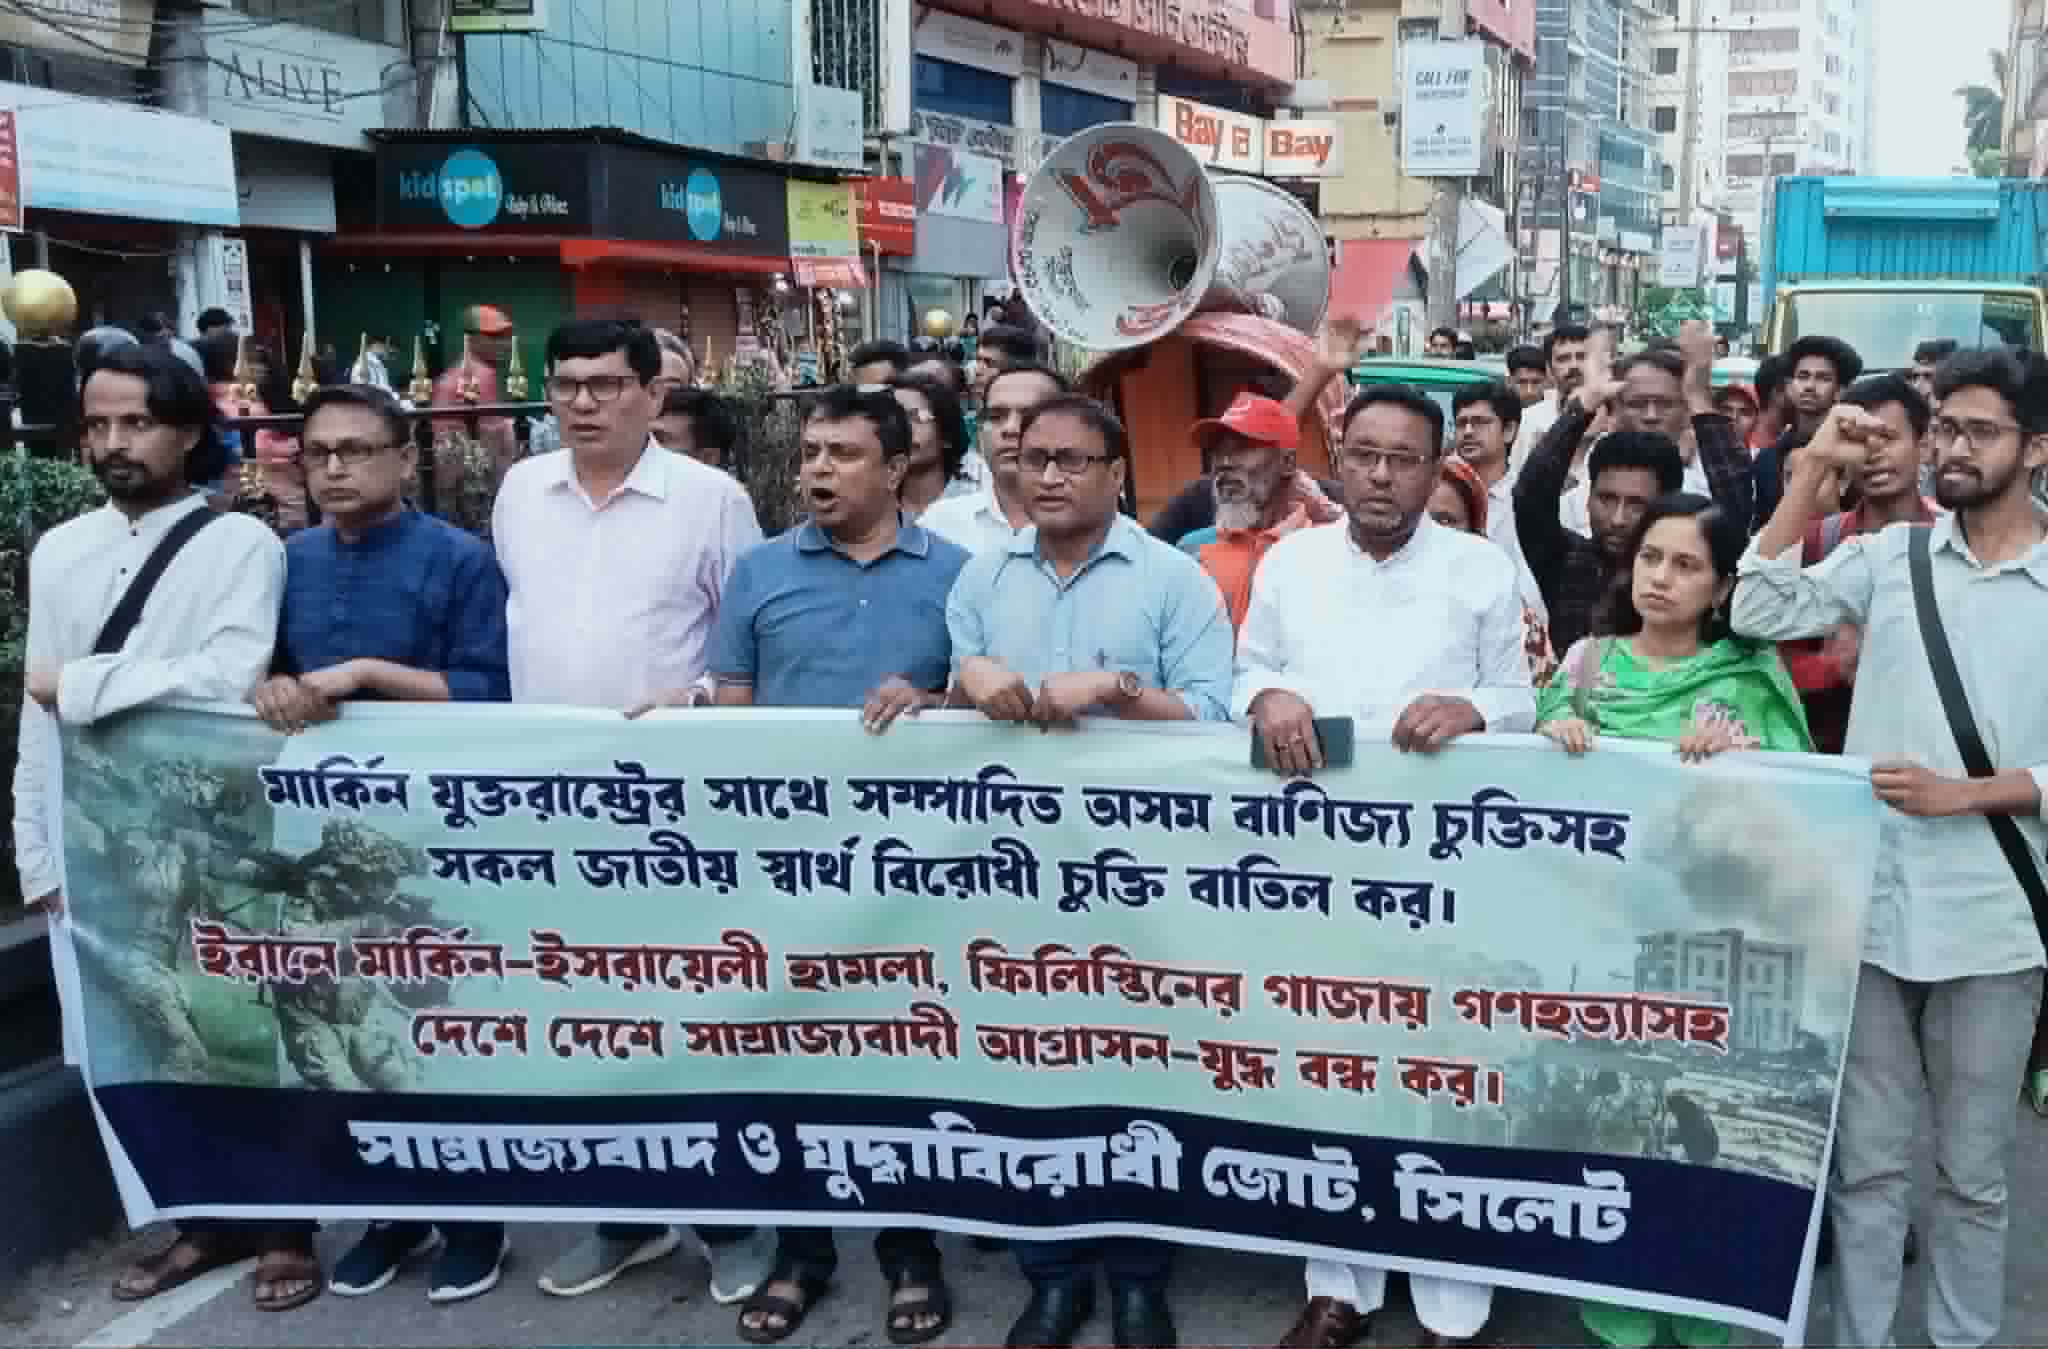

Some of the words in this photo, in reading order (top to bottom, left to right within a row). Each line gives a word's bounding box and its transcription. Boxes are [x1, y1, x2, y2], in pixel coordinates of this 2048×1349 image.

[224, 51, 344, 115] ALIVE
[1175, 101, 1225, 161] Bay
[1271, 129, 1333, 168] Bay
[262, 756, 408, 811] মার্কিন
[429, 760, 686, 829] যুক্তরাষ্ট্রের
[703, 776, 829, 818] সাথে
[847, 765, 1063, 826] সম্পাদিত
[1082, 787, 1212, 831] অসম
[1232, 781, 1413, 848] বাণিজ্য
[1429, 788, 1631, 861] চুক্তিসহ
[427, 848, 556, 886] সকল
[573, 830, 738, 894] জাতীয়
[756, 835, 861, 895] স্বার্থ
[872, 837, 1040, 899] বিরোধী
[1057, 848, 1168, 912] চুক্তি
[1186, 855, 1332, 916] বাতিল
[1351, 877, 1456, 929] কর।
[193, 920, 340, 984] ইরানে
[785, 948, 950, 996] হামলা,
[967, 938, 1243, 1017] ফিলিস্তিনের
[1263, 973, 1430, 1031] গাজায়
[1453, 987, 1729, 1055] গণহত্যাসহ
[413, 1012, 528, 1058] দেশে
[549, 1015, 664, 1060] দেশে
[681, 1002, 960, 1060] সাম্রাজ্যবাদী
[1296, 1050, 1379, 1095] বন্ধ
[1398, 1055, 1504, 1108] কর।
[348, 1119, 719, 1176] সাম্রাজ্যবাদ
[738, 1122, 780, 1174] ও
[1203, 1142, 1377, 1222] জোট,
[1395, 1153, 1632, 1243] সিলেট
